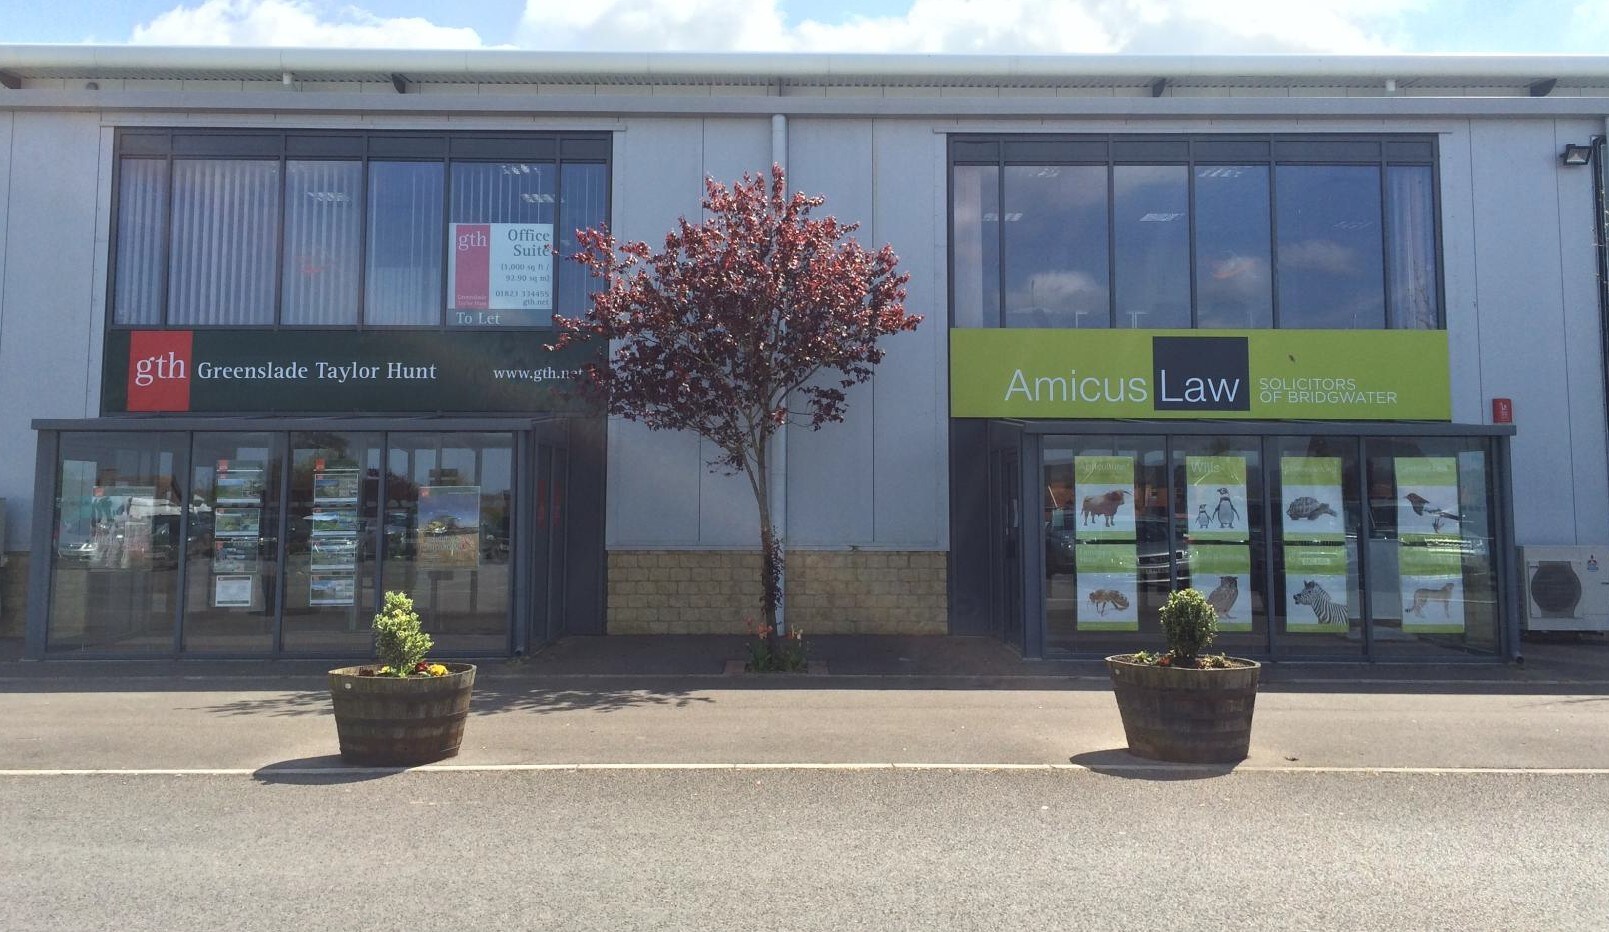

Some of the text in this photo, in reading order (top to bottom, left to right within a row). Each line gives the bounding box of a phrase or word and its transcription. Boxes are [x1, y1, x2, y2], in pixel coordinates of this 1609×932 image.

[458, 231, 487, 251] gth
[508, 228, 550, 242] Office
[513, 244, 549, 257] Suite
[456, 312, 500, 325] To Let
[135, 352, 187, 386] gth
[197, 361, 437, 383] Greenslade Taylor Hunt
[1004, 369, 1239, 403] Amicus Law
[1260, 377, 1356, 390] SOLICITORS
[1259, 391, 1397, 404] OF BRIDGWATER
[1191, 461, 1221, 473] Wills
